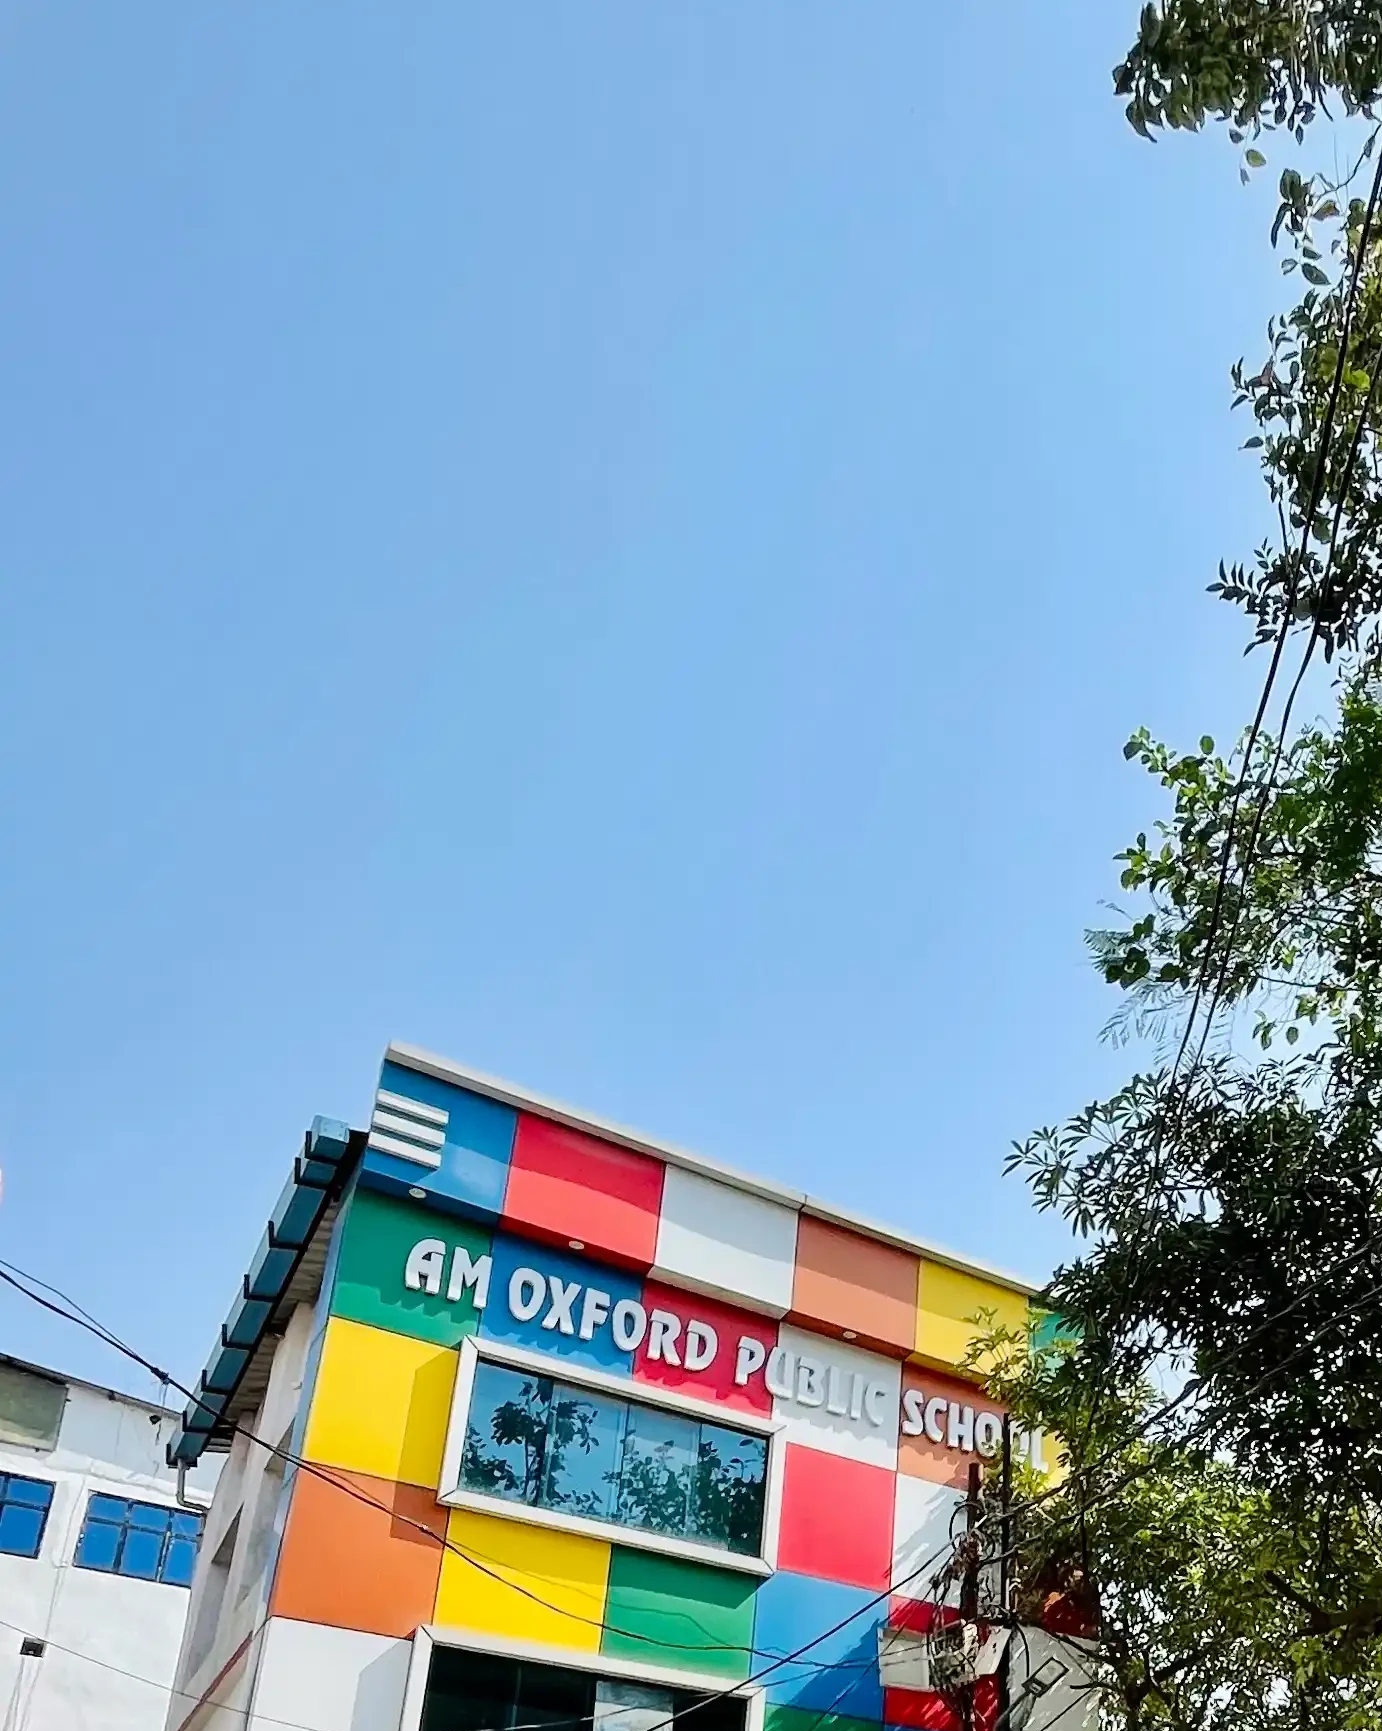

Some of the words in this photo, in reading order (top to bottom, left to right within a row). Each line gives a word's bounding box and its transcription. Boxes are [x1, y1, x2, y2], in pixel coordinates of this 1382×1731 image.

[405, 1237, 491, 1309] AM
[507, 1266, 719, 1373] OXFORD
[734, 1335, 889, 1427] PUBLIC
